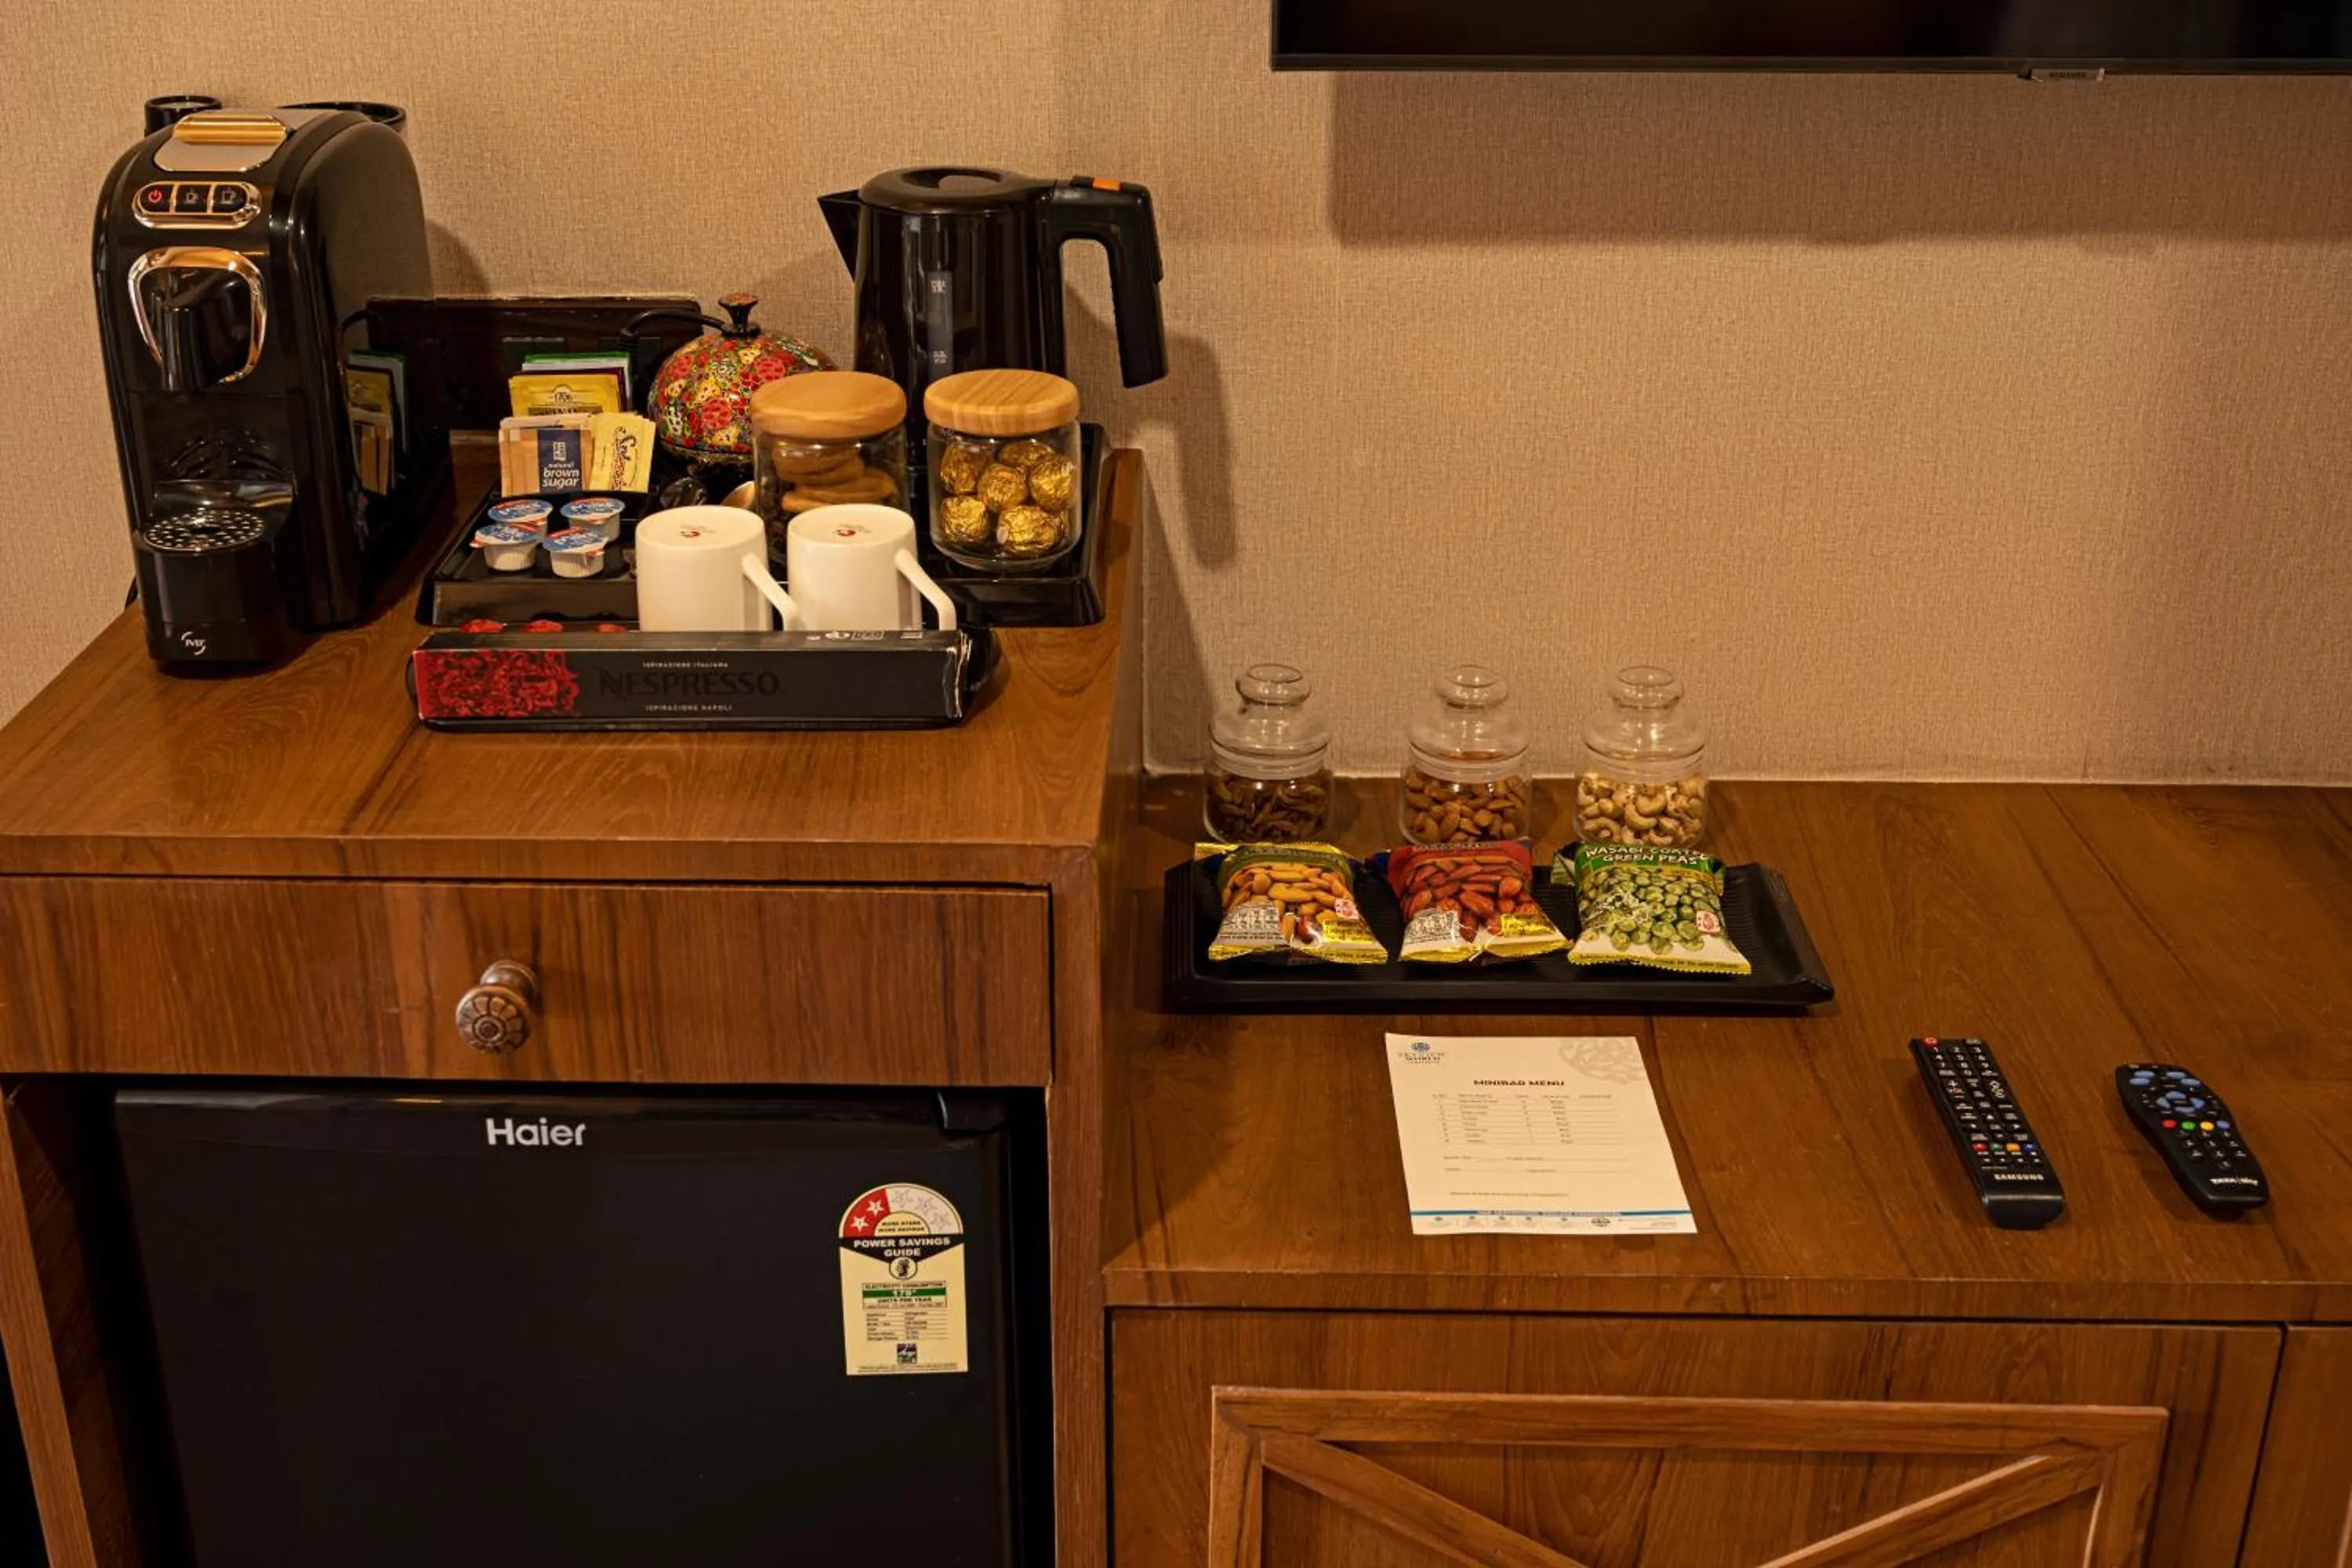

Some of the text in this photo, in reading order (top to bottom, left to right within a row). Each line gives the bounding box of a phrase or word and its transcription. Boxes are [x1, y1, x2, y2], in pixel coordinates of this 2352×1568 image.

[543, 466, 579, 477] brown
[541, 478, 579, 490] sugar
[598, 670, 780, 701] NESPRESSO
[1586, 847, 1643, 858] WASABI
[1659, 855, 1697, 865] PEAS
[486, 1117, 586, 1145] Haier
[854, 1236, 950, 1248] POWER SAVINGS
[884, 1248, 921, 1257] GUIDE
